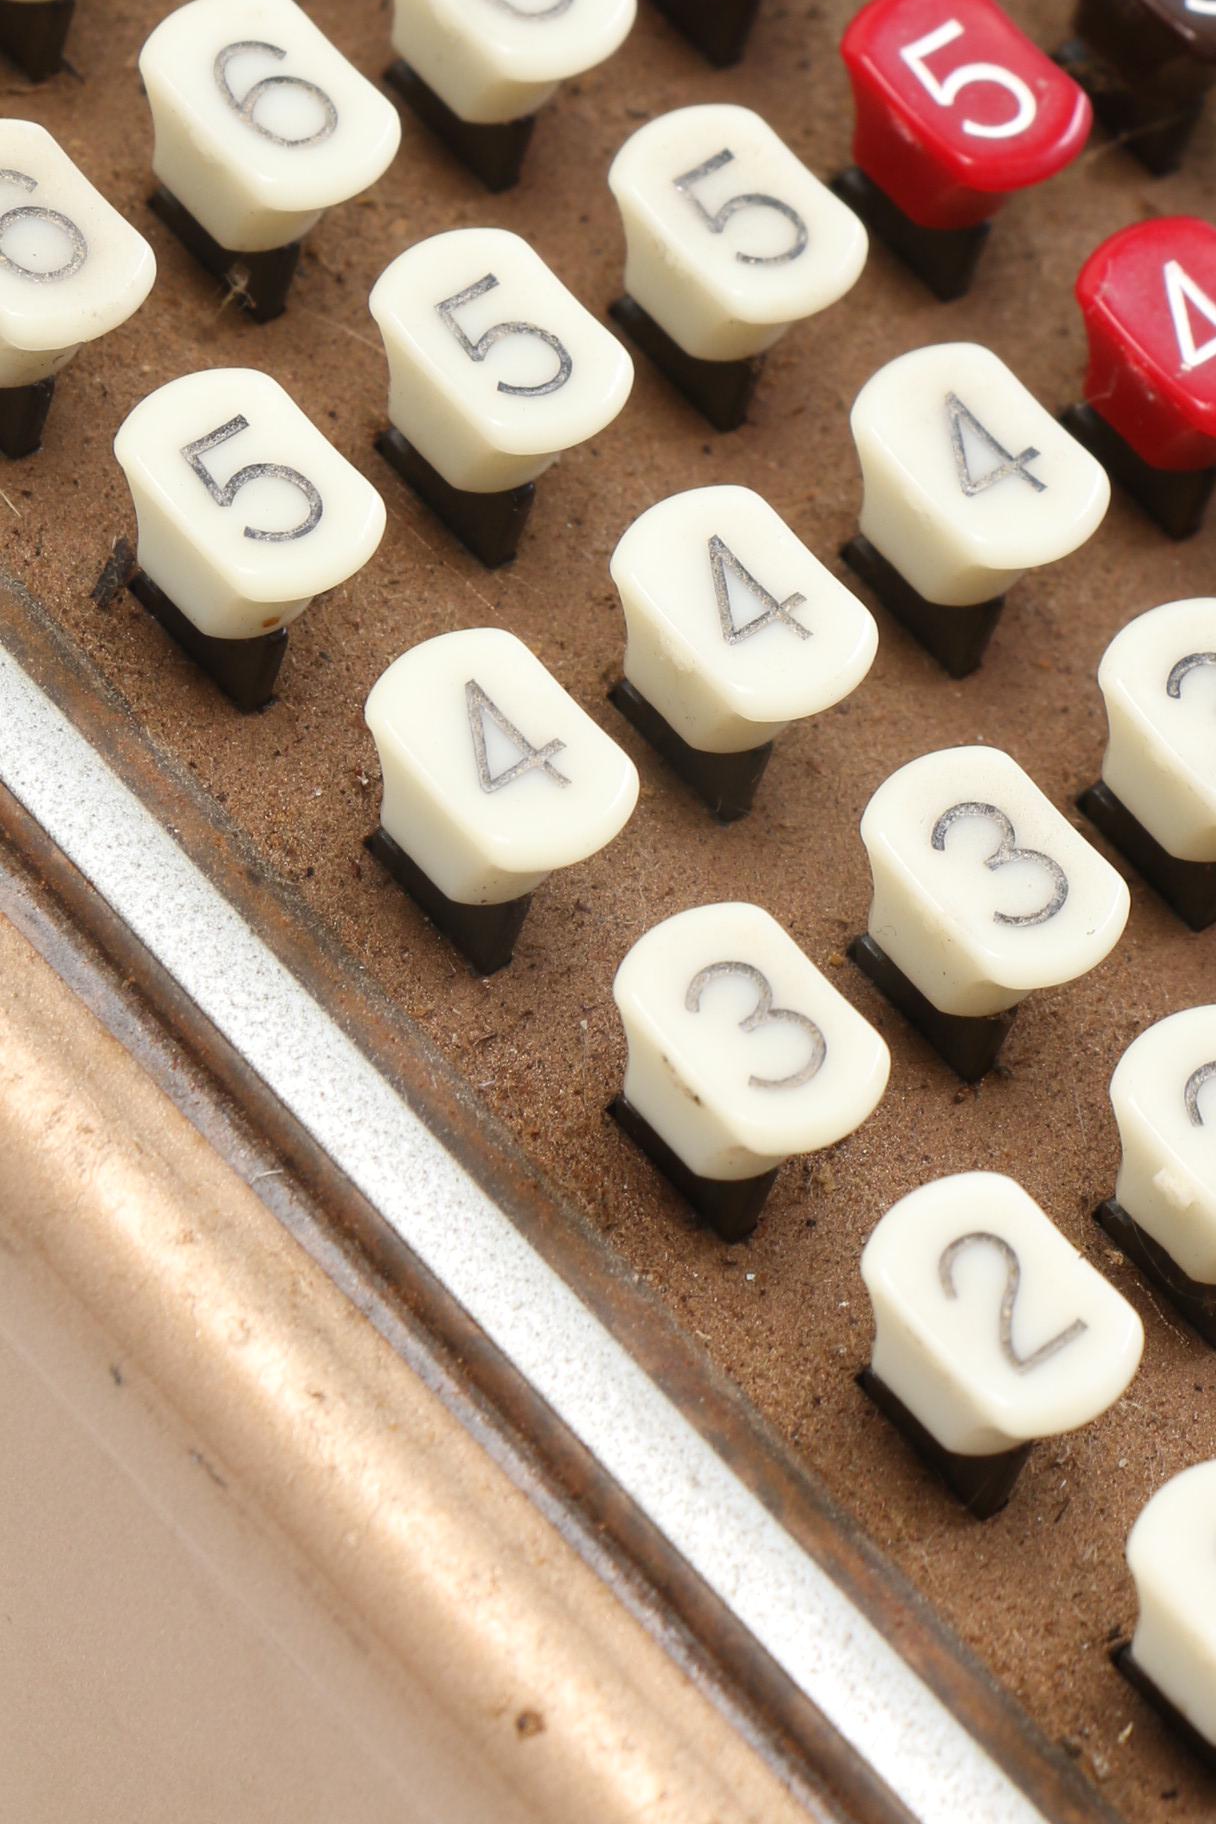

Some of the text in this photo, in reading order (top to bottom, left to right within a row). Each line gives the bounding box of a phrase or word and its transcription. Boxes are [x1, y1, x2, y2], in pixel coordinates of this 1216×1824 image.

[214, 40, 339, 149] 6
[901, 20, 1036, 138] 5
[0, 168, 88, 283] 6
[673, 148, 809, 266] 5
[435, 273, 573, 398] 5
[181, 414, 324, 543] 5
[944, 392, 1047, 493] 4
[708, 534, 812, 645] 4
[464, 678, 571, 794] 4
[930, 801, 1069, 928] 3
[685, 960, 828, 1091] 3
[937, 1230, 1088, 1371] 2
